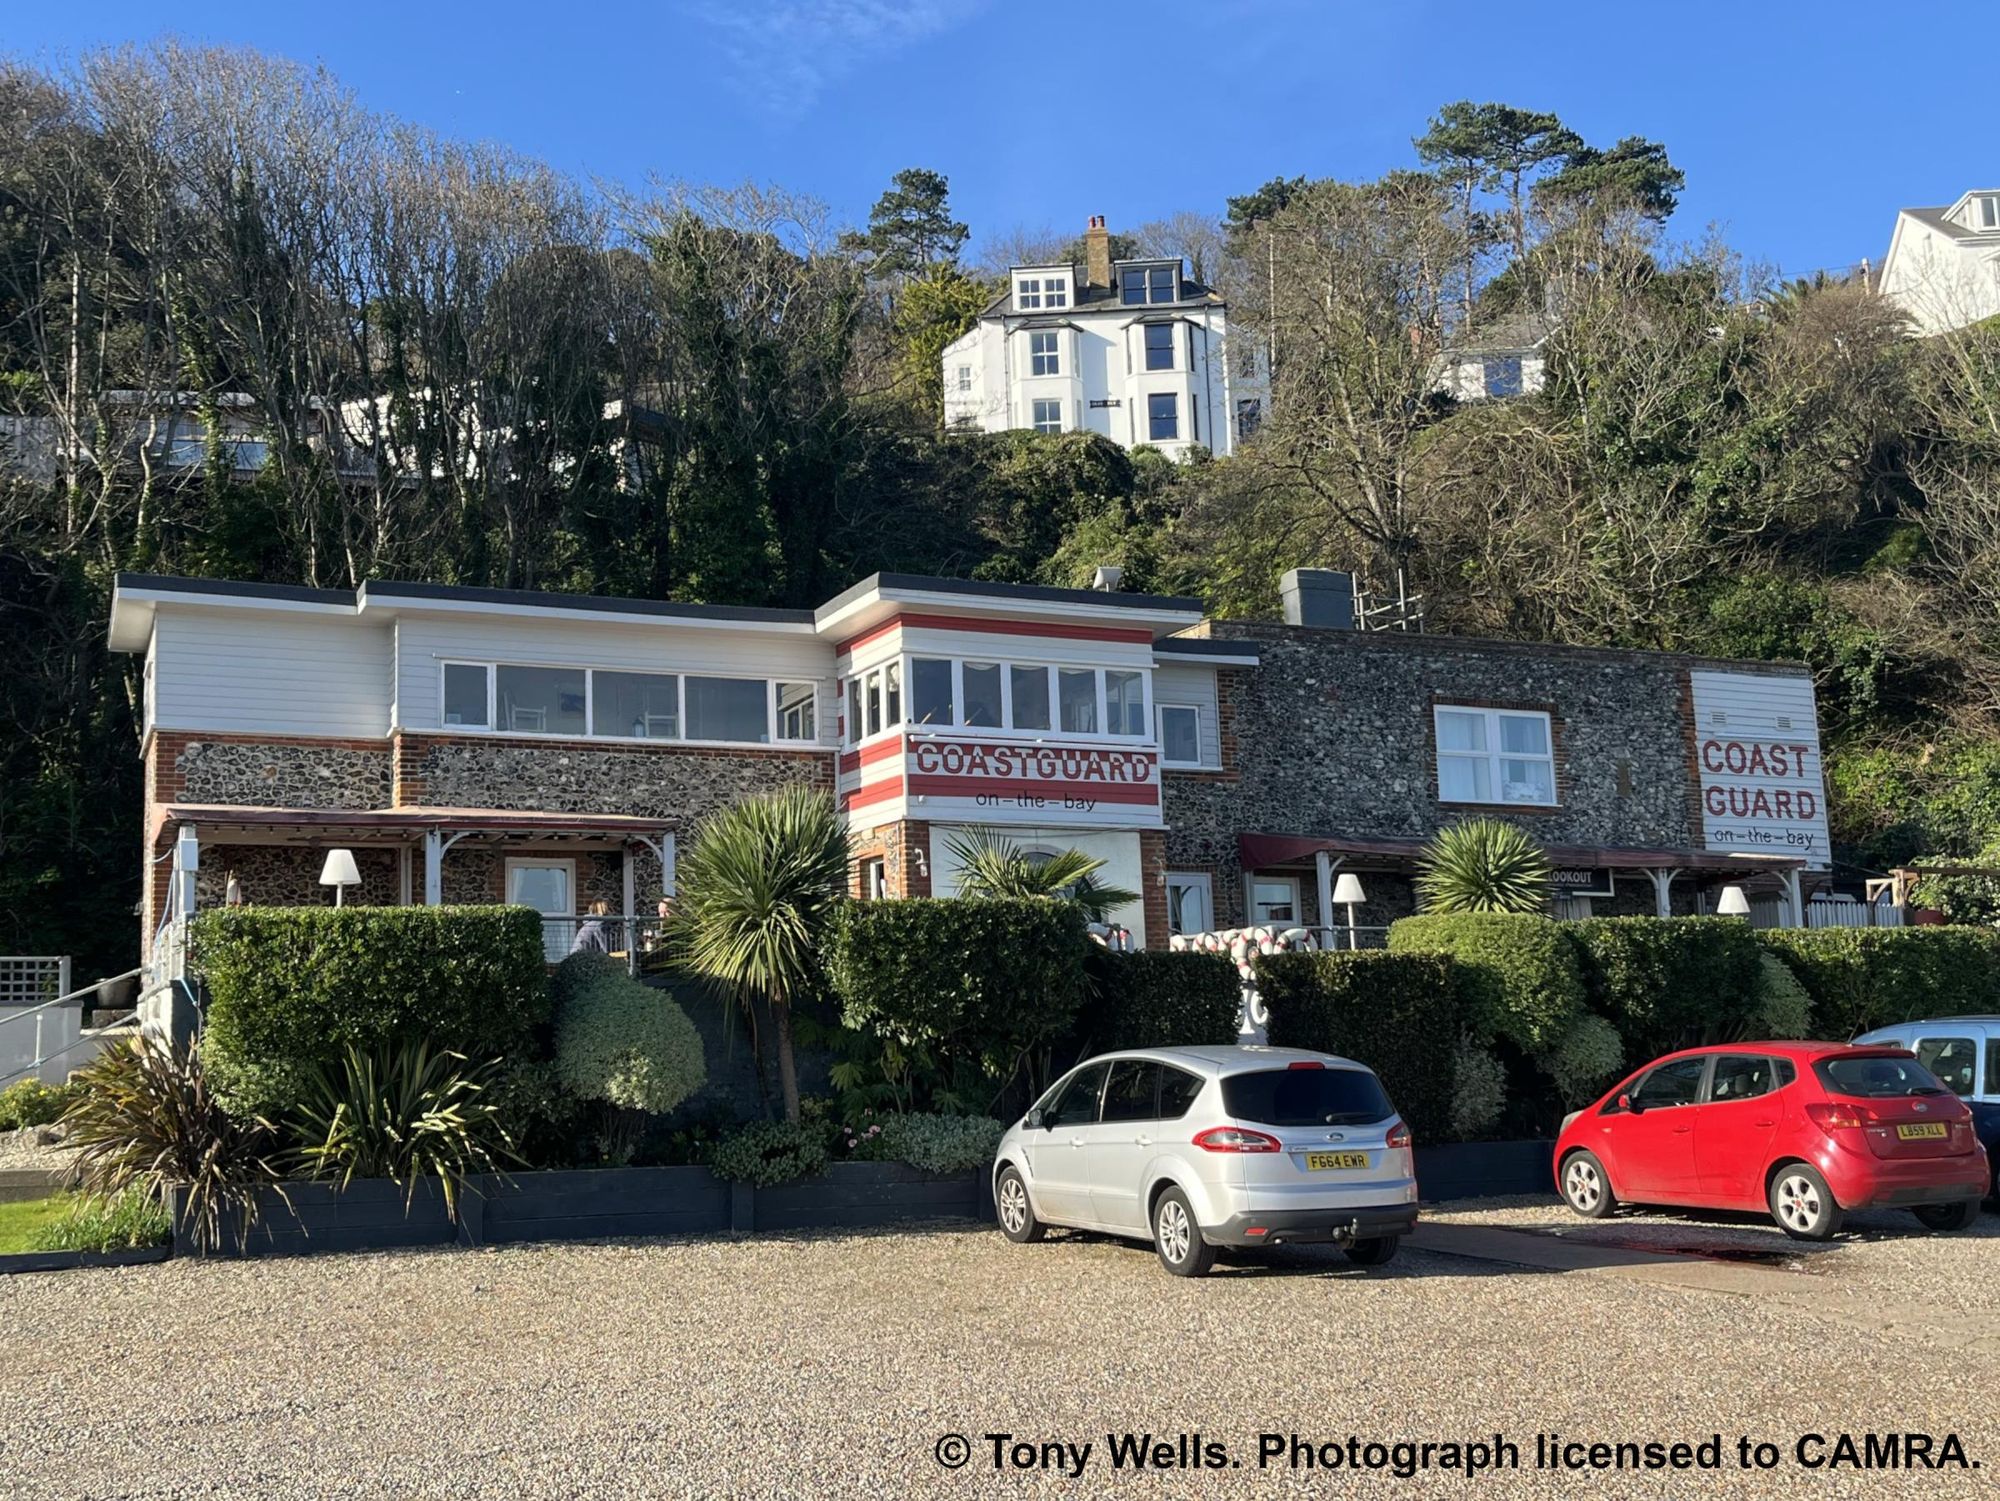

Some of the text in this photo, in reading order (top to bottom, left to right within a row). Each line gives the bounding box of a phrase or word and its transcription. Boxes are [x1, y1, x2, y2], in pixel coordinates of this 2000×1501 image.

[917, 743, 1150, 783] COASTGUARD
[1703, 740, 1809, 778] COAST
[1706, 786, 1816, 819] GUARD
[1311, 1154, 1366, 1169] FG64 EWR
